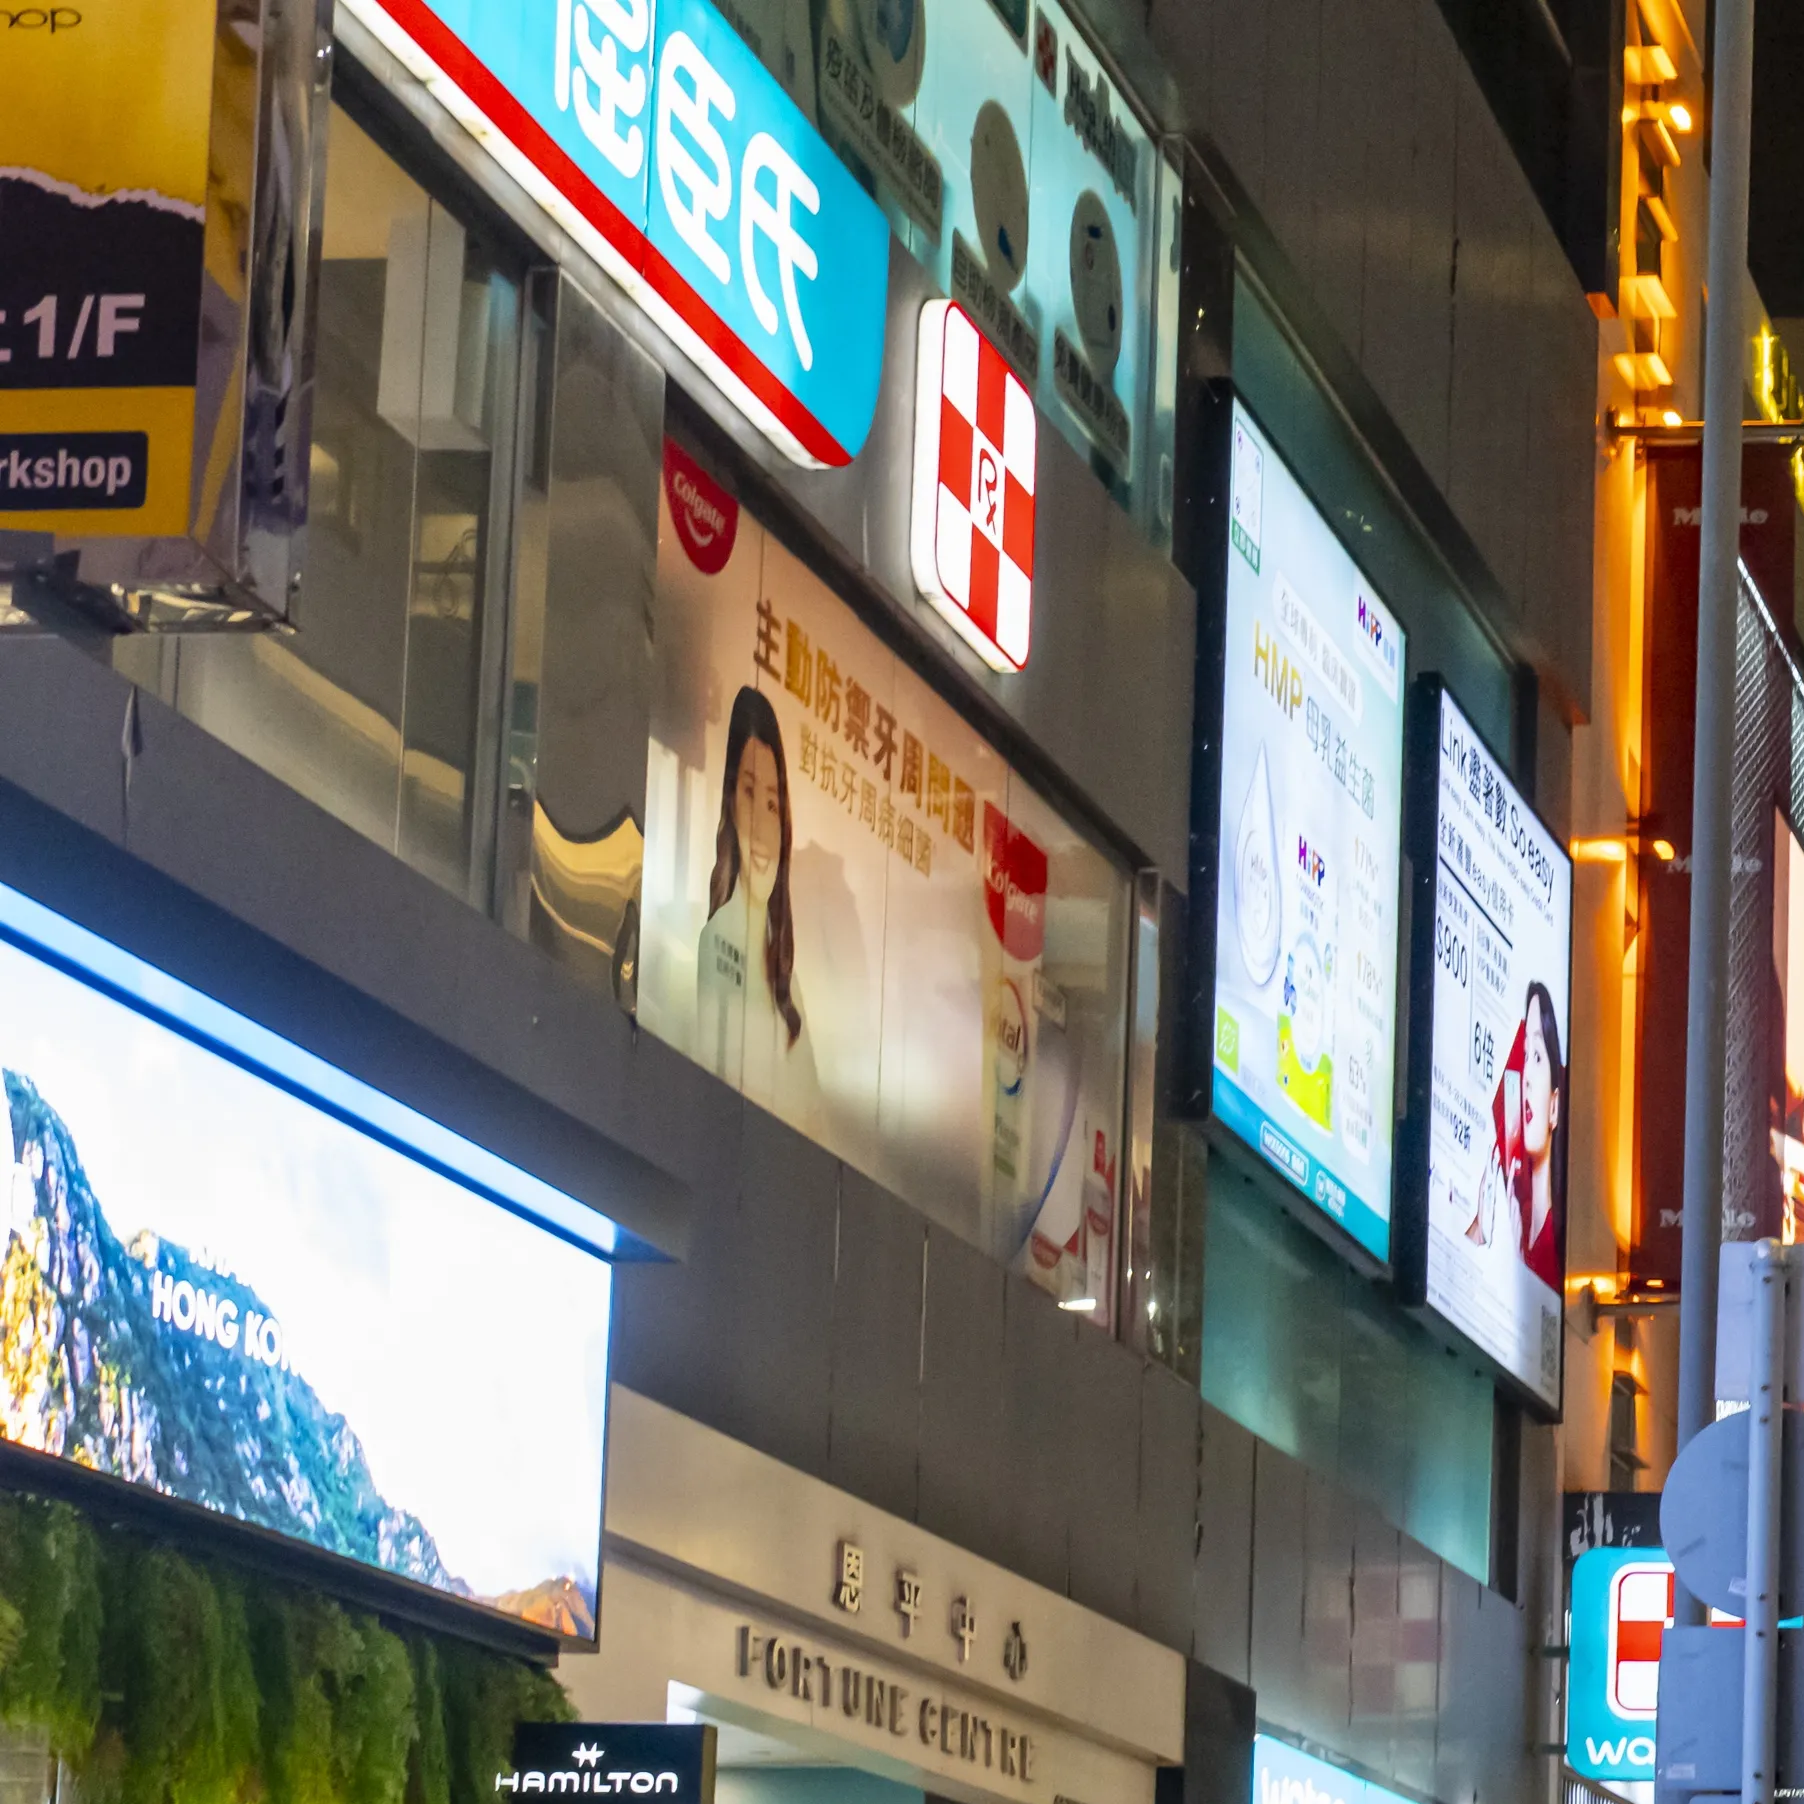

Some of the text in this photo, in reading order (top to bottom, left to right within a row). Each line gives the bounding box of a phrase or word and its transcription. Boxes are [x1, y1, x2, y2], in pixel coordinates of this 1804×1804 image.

[22, 292, 146, 360] 1/F
[671, 468, 729, 536] Colgate
[1357, 594, 1383, 647] HiPP
[1254, 620, 1303, 722] HMP
[1306, 695, 1375, 821] 母乳益生菌
[1440, 708, 1467, 783] Link
[1298, 833, 1325, 887] HiPP
[1435, 914, 1468, 989] $900
[152, 1270, 239, 1342] HONG
[836, 1540, 1028, 1681] 恩平中心
[736, 1624, 1035, 1783] FORTUNE CENTRE
[495, 1771, 678, 1794] HAMILTON
